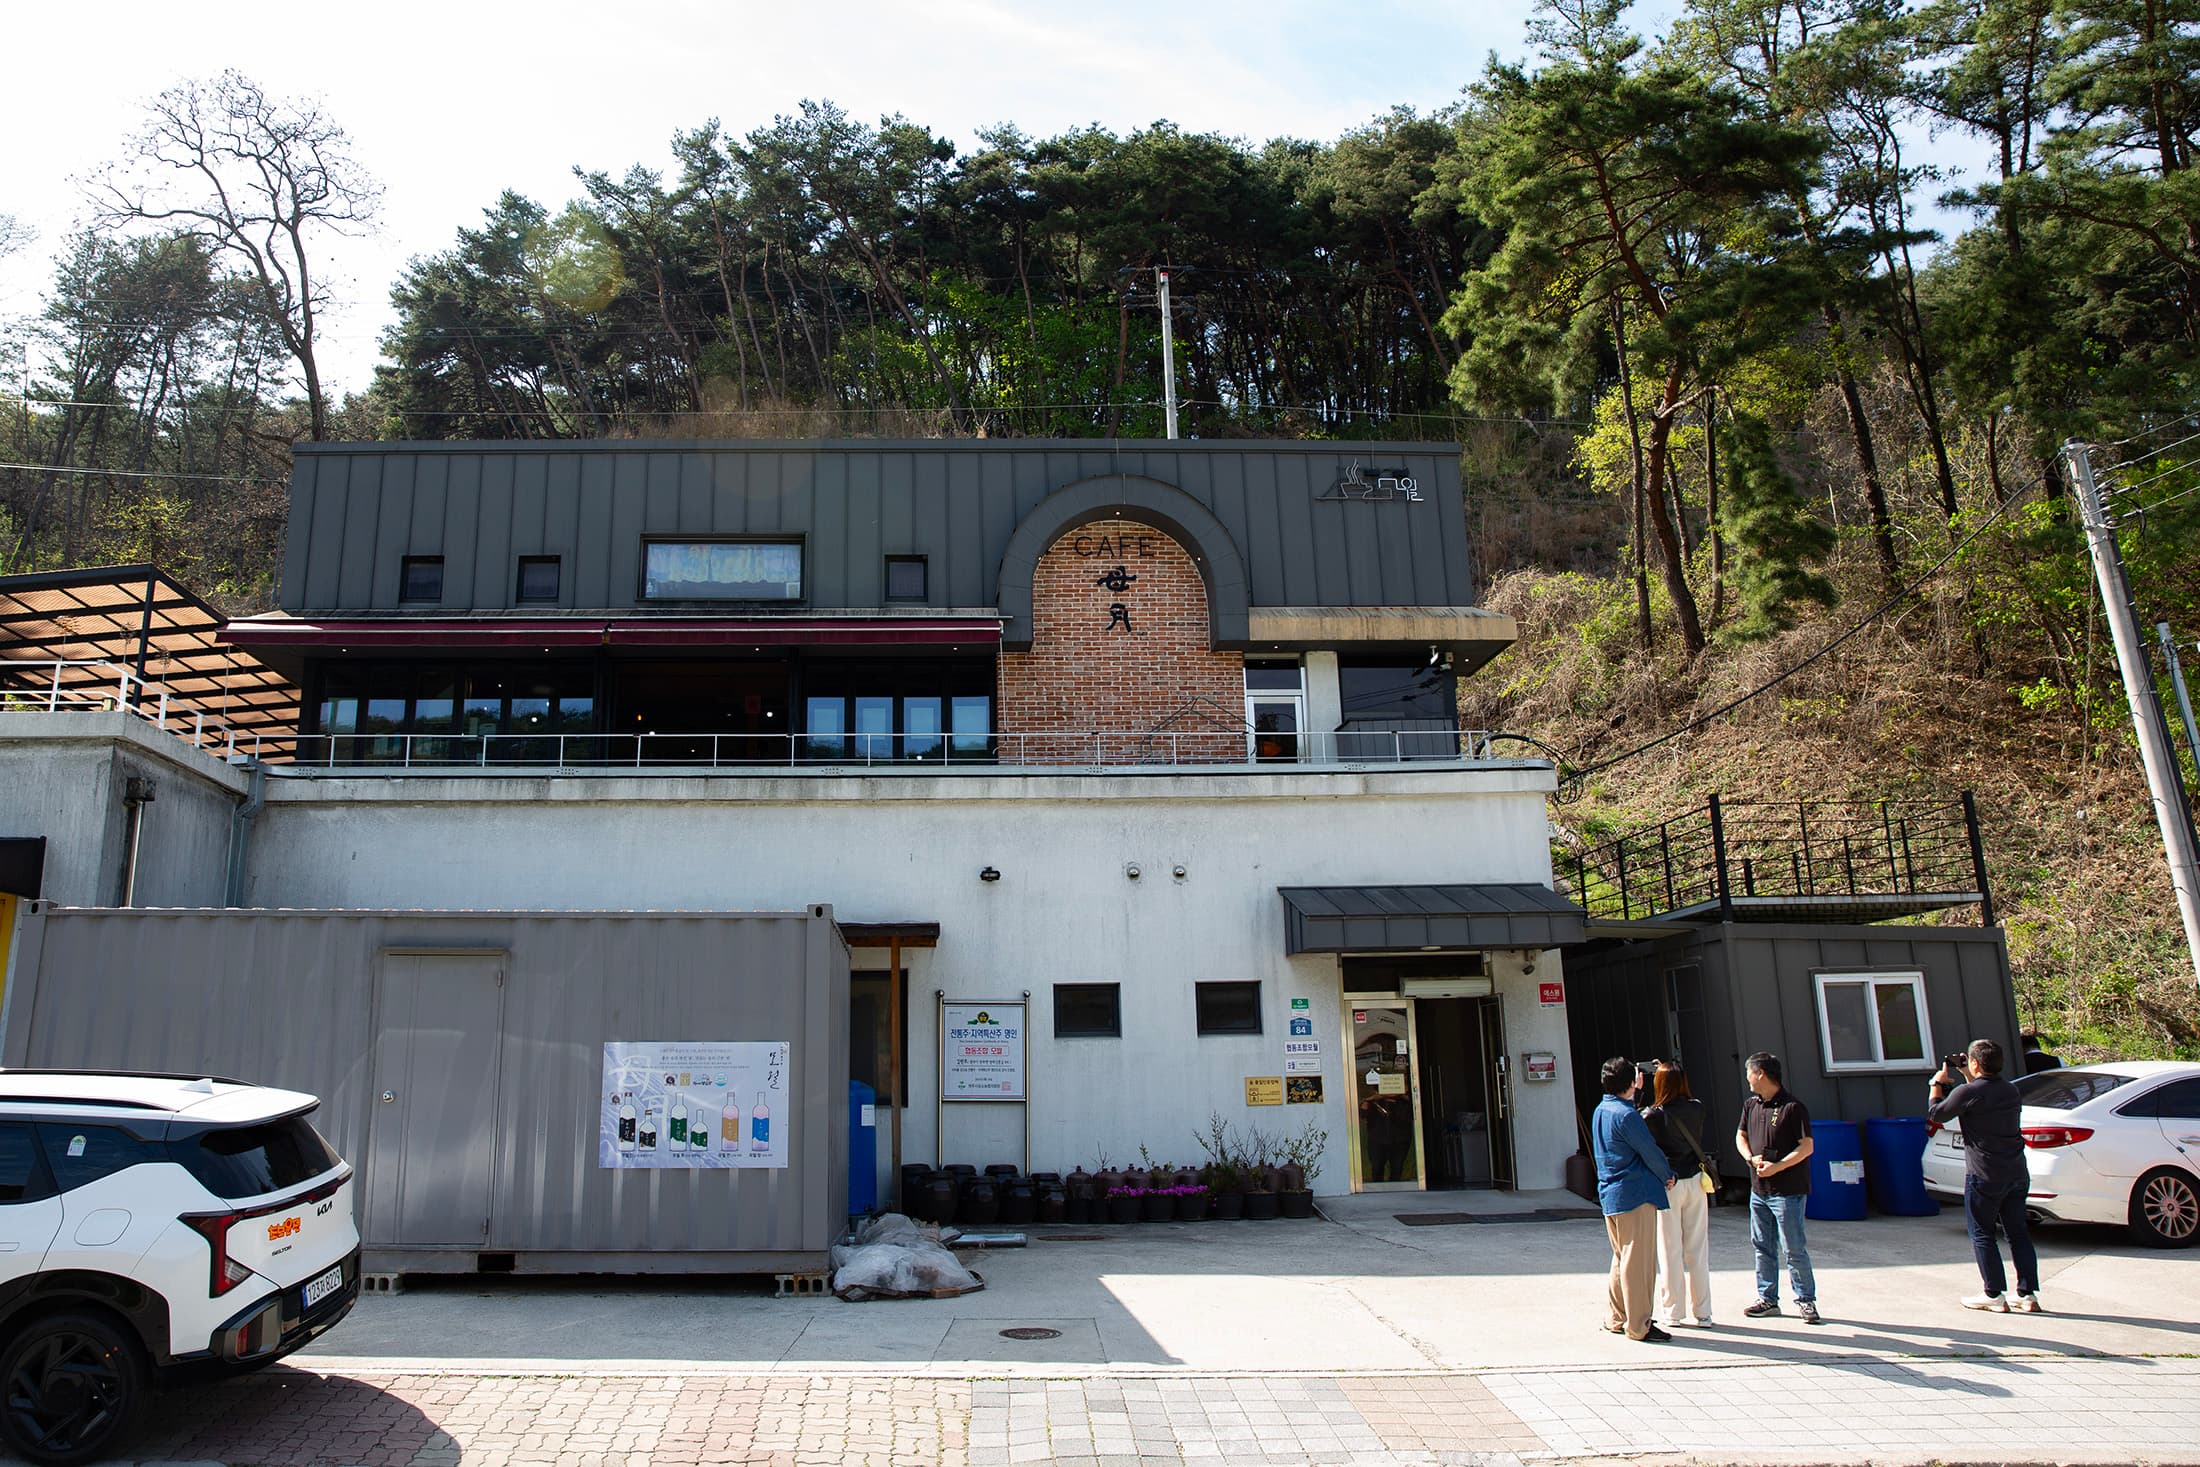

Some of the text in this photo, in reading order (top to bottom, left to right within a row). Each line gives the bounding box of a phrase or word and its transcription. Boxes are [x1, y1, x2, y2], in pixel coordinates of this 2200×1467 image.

[1074, 536, 1155, 557] CAFE
[1295, 1026, 1306, 1034] 84
[317, 1201, 333, 1216] KIA
